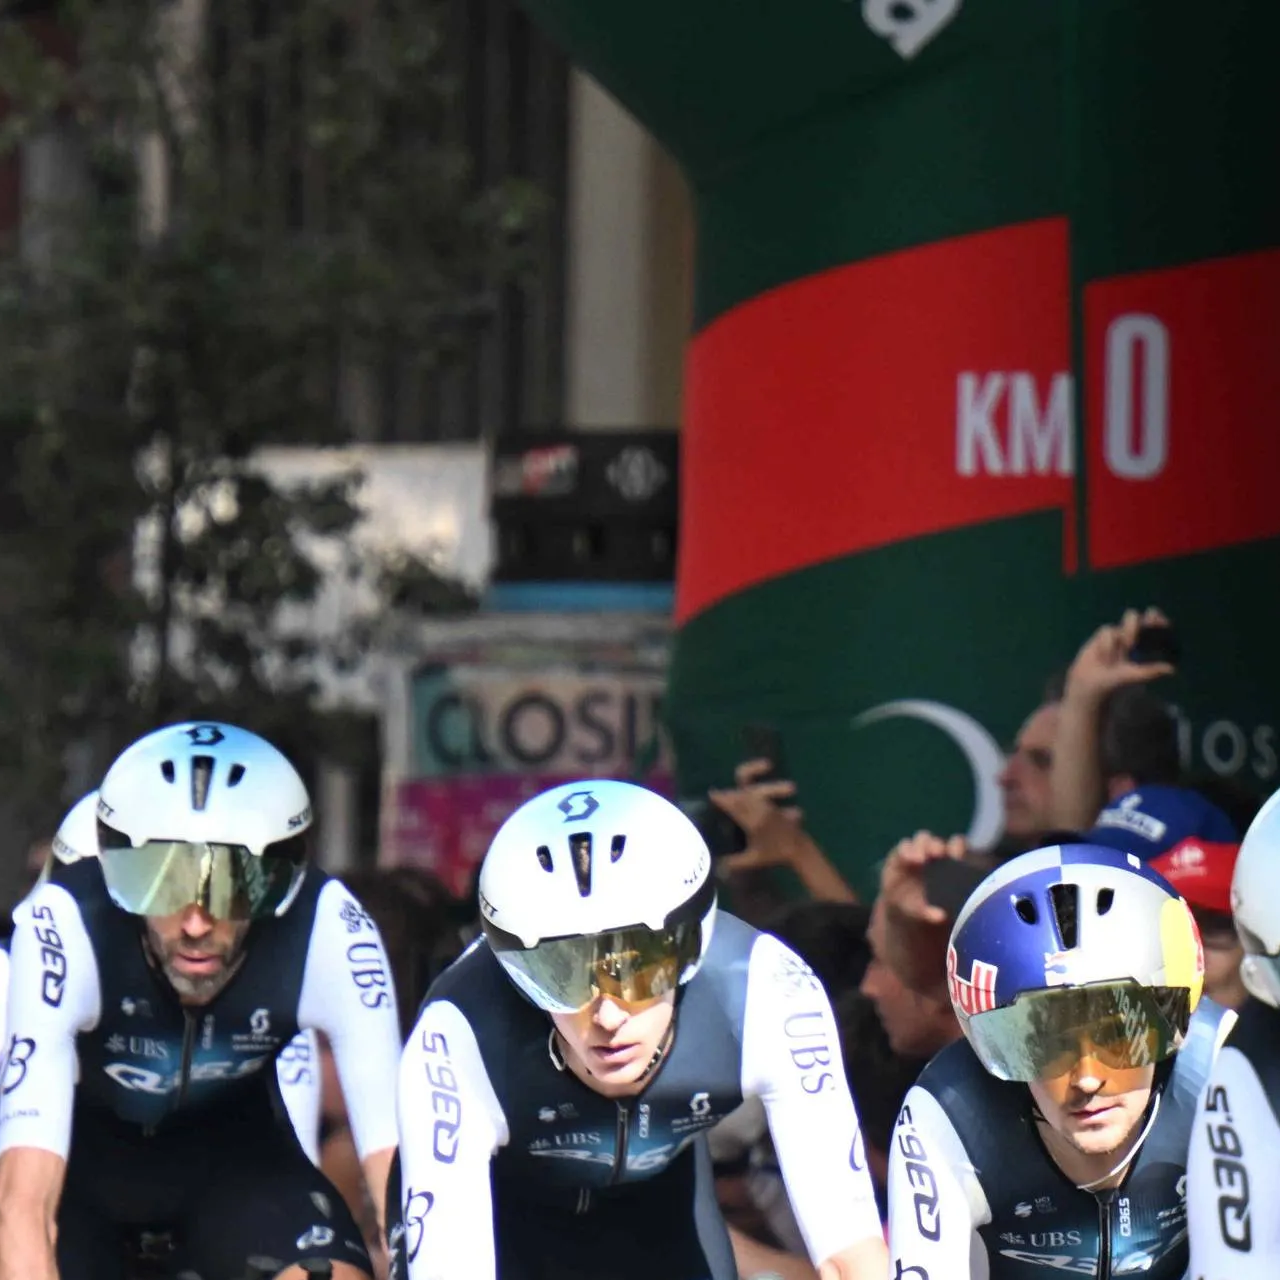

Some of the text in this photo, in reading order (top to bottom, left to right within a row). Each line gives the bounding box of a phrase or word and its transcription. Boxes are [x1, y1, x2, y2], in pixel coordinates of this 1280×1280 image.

[955, 313, 1170, 479] KM 0
[32, 905, 67, 1009] Q36.5
[346, 941, 392, 1010] UBS
[279, 1038, 314, 1086] BS
[422, 1030, 463, 1165] Q36.5
[784, 1011, 837, 1094] UBS
[897, 1104, 942, 1242] Q36.5
[1206, 1084, 1253, 1254] Q36.5
[1030, 1230, 1082, 1248] UBS
